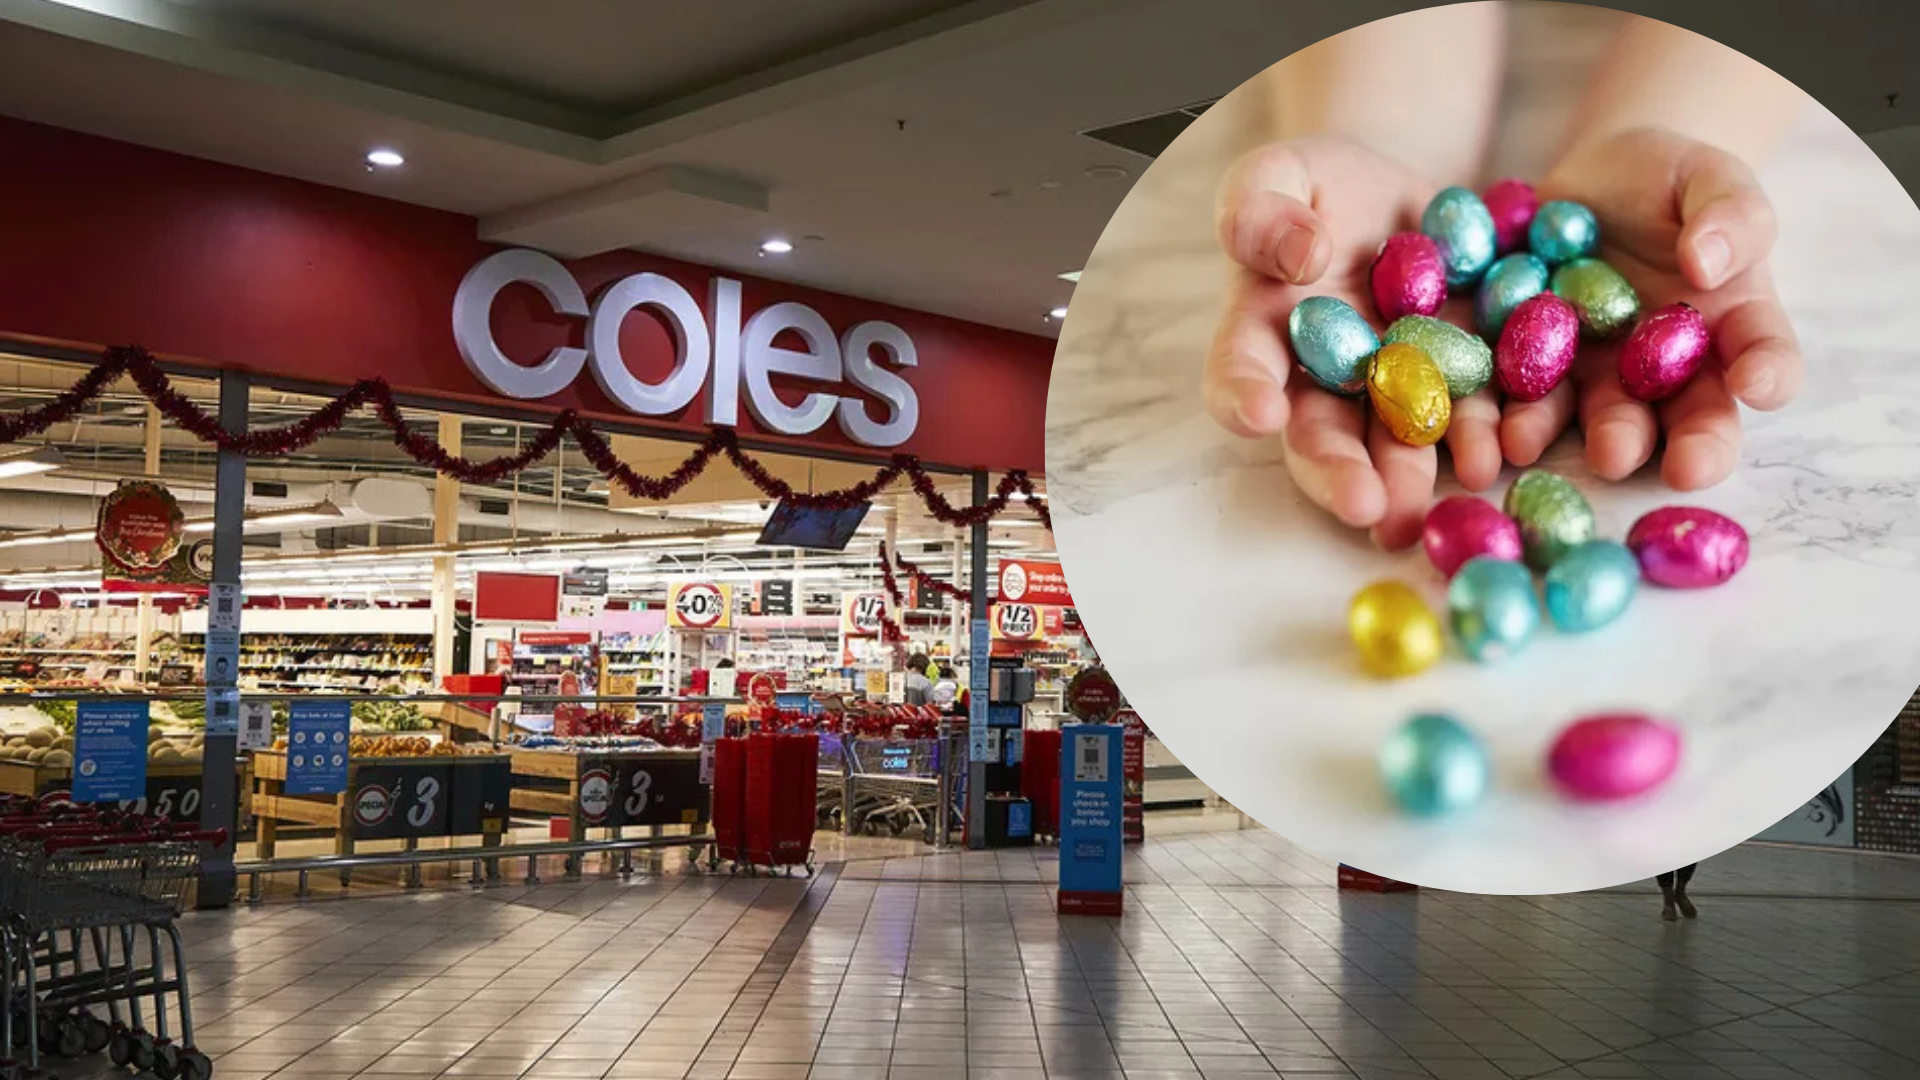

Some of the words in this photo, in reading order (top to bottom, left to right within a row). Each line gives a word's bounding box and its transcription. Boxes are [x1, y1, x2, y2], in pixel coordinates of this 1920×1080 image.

[452, 247, 919, 447] coles
[1004, 604, 1031, 623] 1/2
[1002, 622, 1032, 633] PRICE
[882, 757, 908, 769] coles
[624, 771, 652, 816] 3
[1076, 790, 1106, 799] Please
[407, 777, 440, 827] 3
[1076, 808, 1105, 817] before
[1070, 819, 1087, 827] you
[1088, 817, 1110, 828] shop
